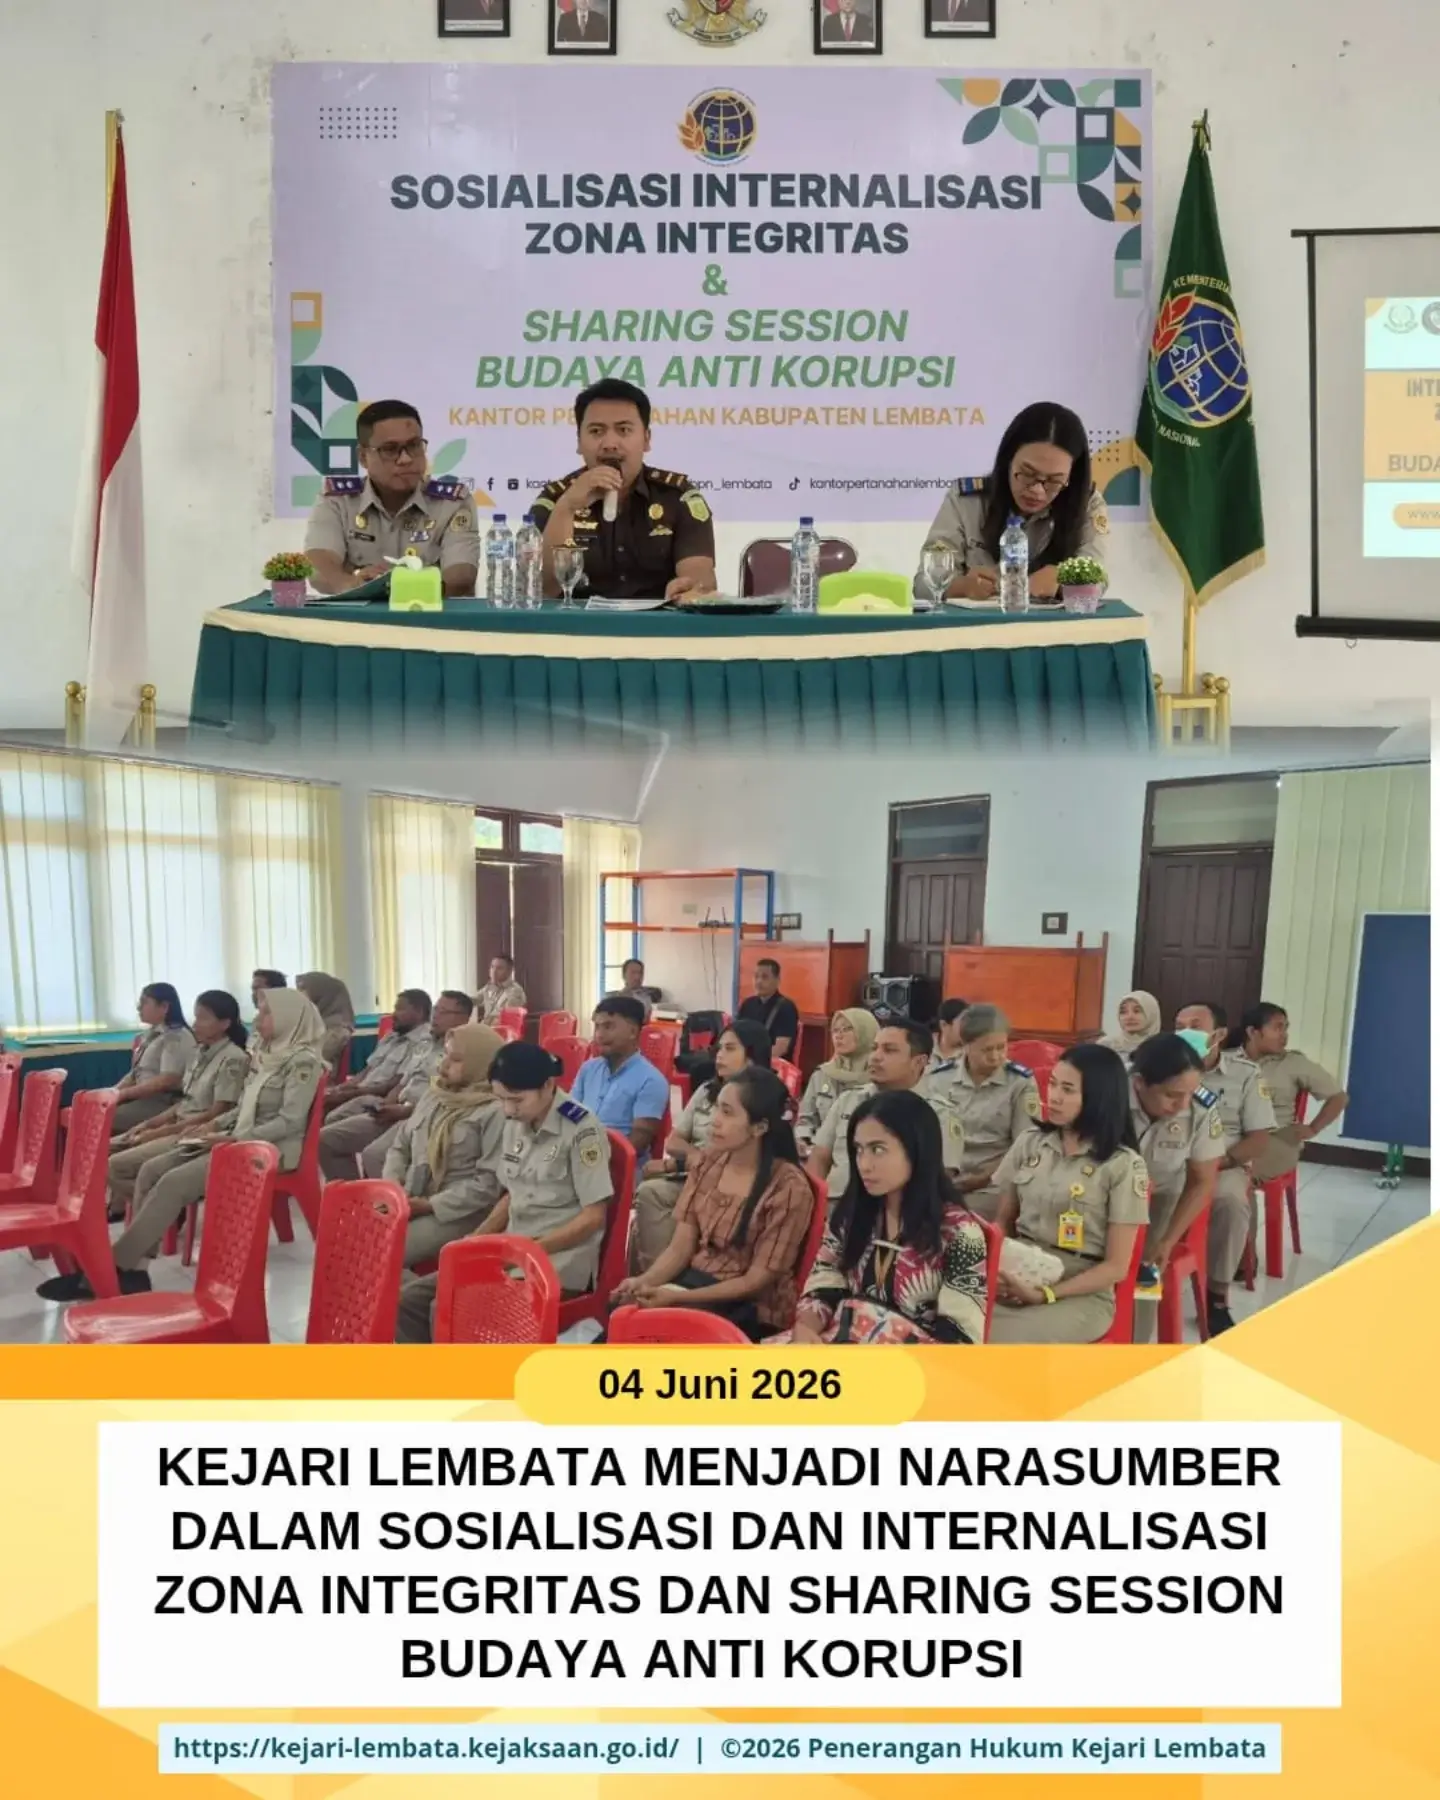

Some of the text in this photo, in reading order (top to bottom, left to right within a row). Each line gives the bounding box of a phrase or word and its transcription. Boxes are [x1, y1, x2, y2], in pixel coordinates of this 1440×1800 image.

[390, 173, 1042, 210] SOSIALISASI INTERNALISASI
[525, 221, 909, 254] ZONA INTEGRITAS
[701, 263, 729, 297] &
[523, 309, 909, 343] SHARING SESSION
[475, 355, 956, 389] BUDAYA ANTI KORUPSI
[449, 406, 986, 427] KANTOR PEAHAN KABUPATEN LEMBATA
